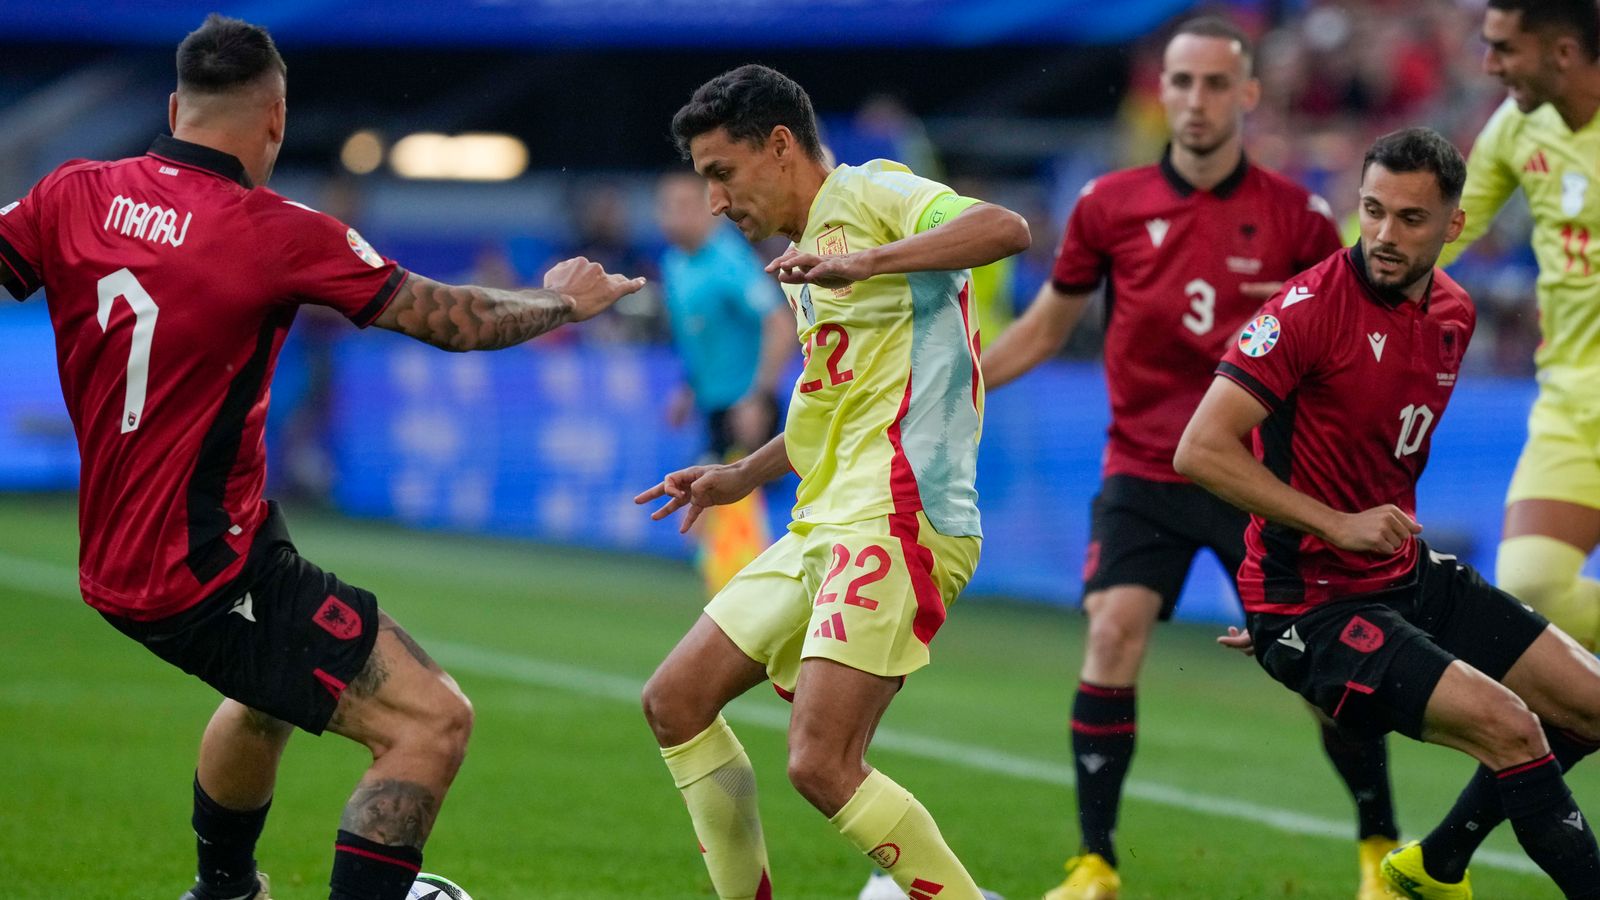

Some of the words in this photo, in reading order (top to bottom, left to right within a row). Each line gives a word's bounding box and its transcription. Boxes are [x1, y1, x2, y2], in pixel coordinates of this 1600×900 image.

[103, 195, 193, 248] MANAJ
[1560, 222, 1592, 277] 11
[1182, 278, 1216, 335] 3
[96, 267, 160, 434] 7
[1394, 403, 1434, 460] 10
[815, 543, 892, 612] 22
